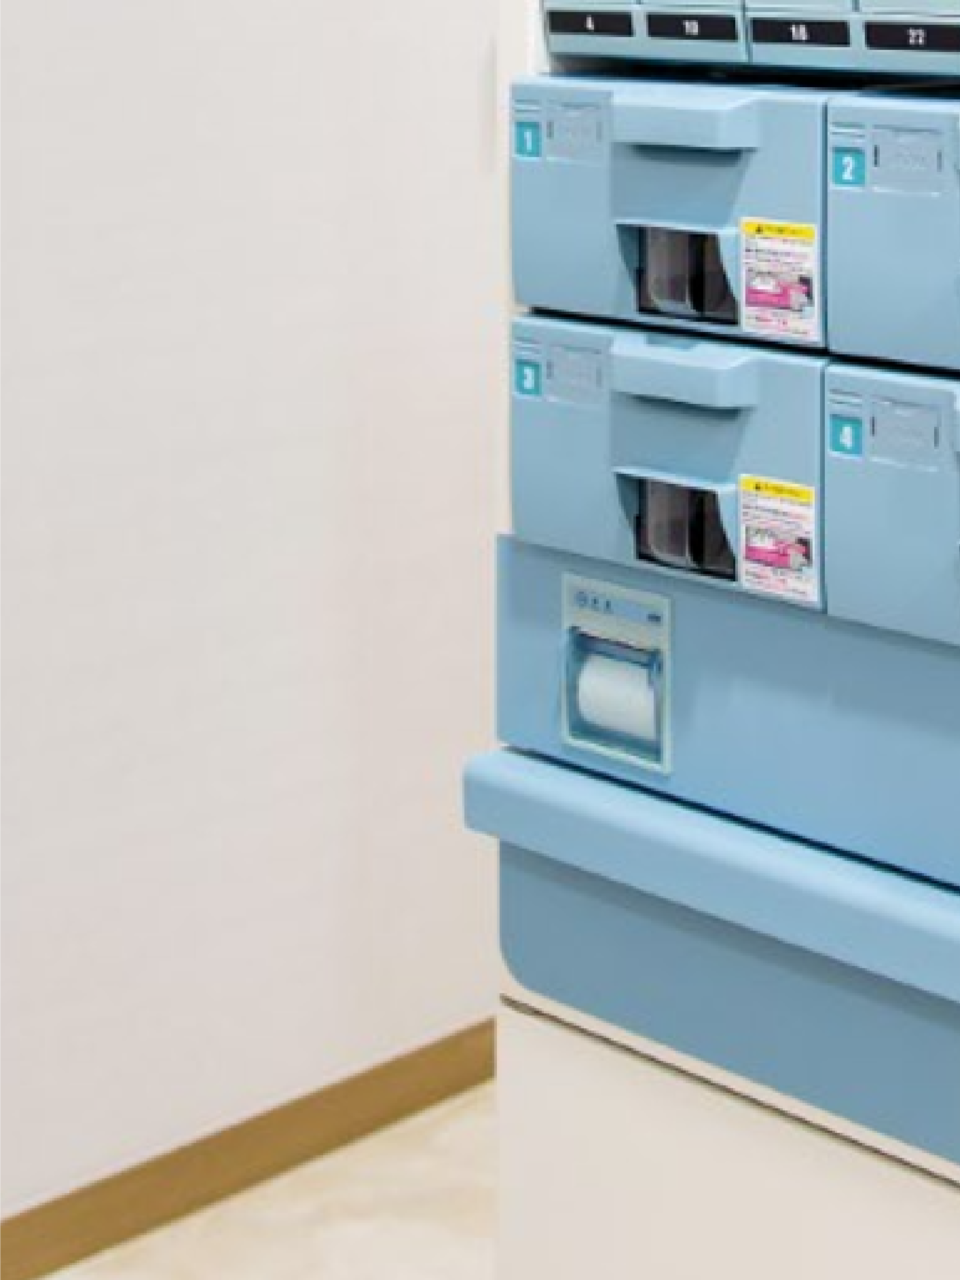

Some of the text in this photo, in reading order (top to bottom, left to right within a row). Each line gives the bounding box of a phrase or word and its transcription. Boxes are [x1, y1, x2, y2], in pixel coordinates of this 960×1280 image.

[523, 131, 533, 151] 1
[842, 157, 855, 179] 2
[522, 366, 534, 389] 3
[839, 424, 853, 448] 4
